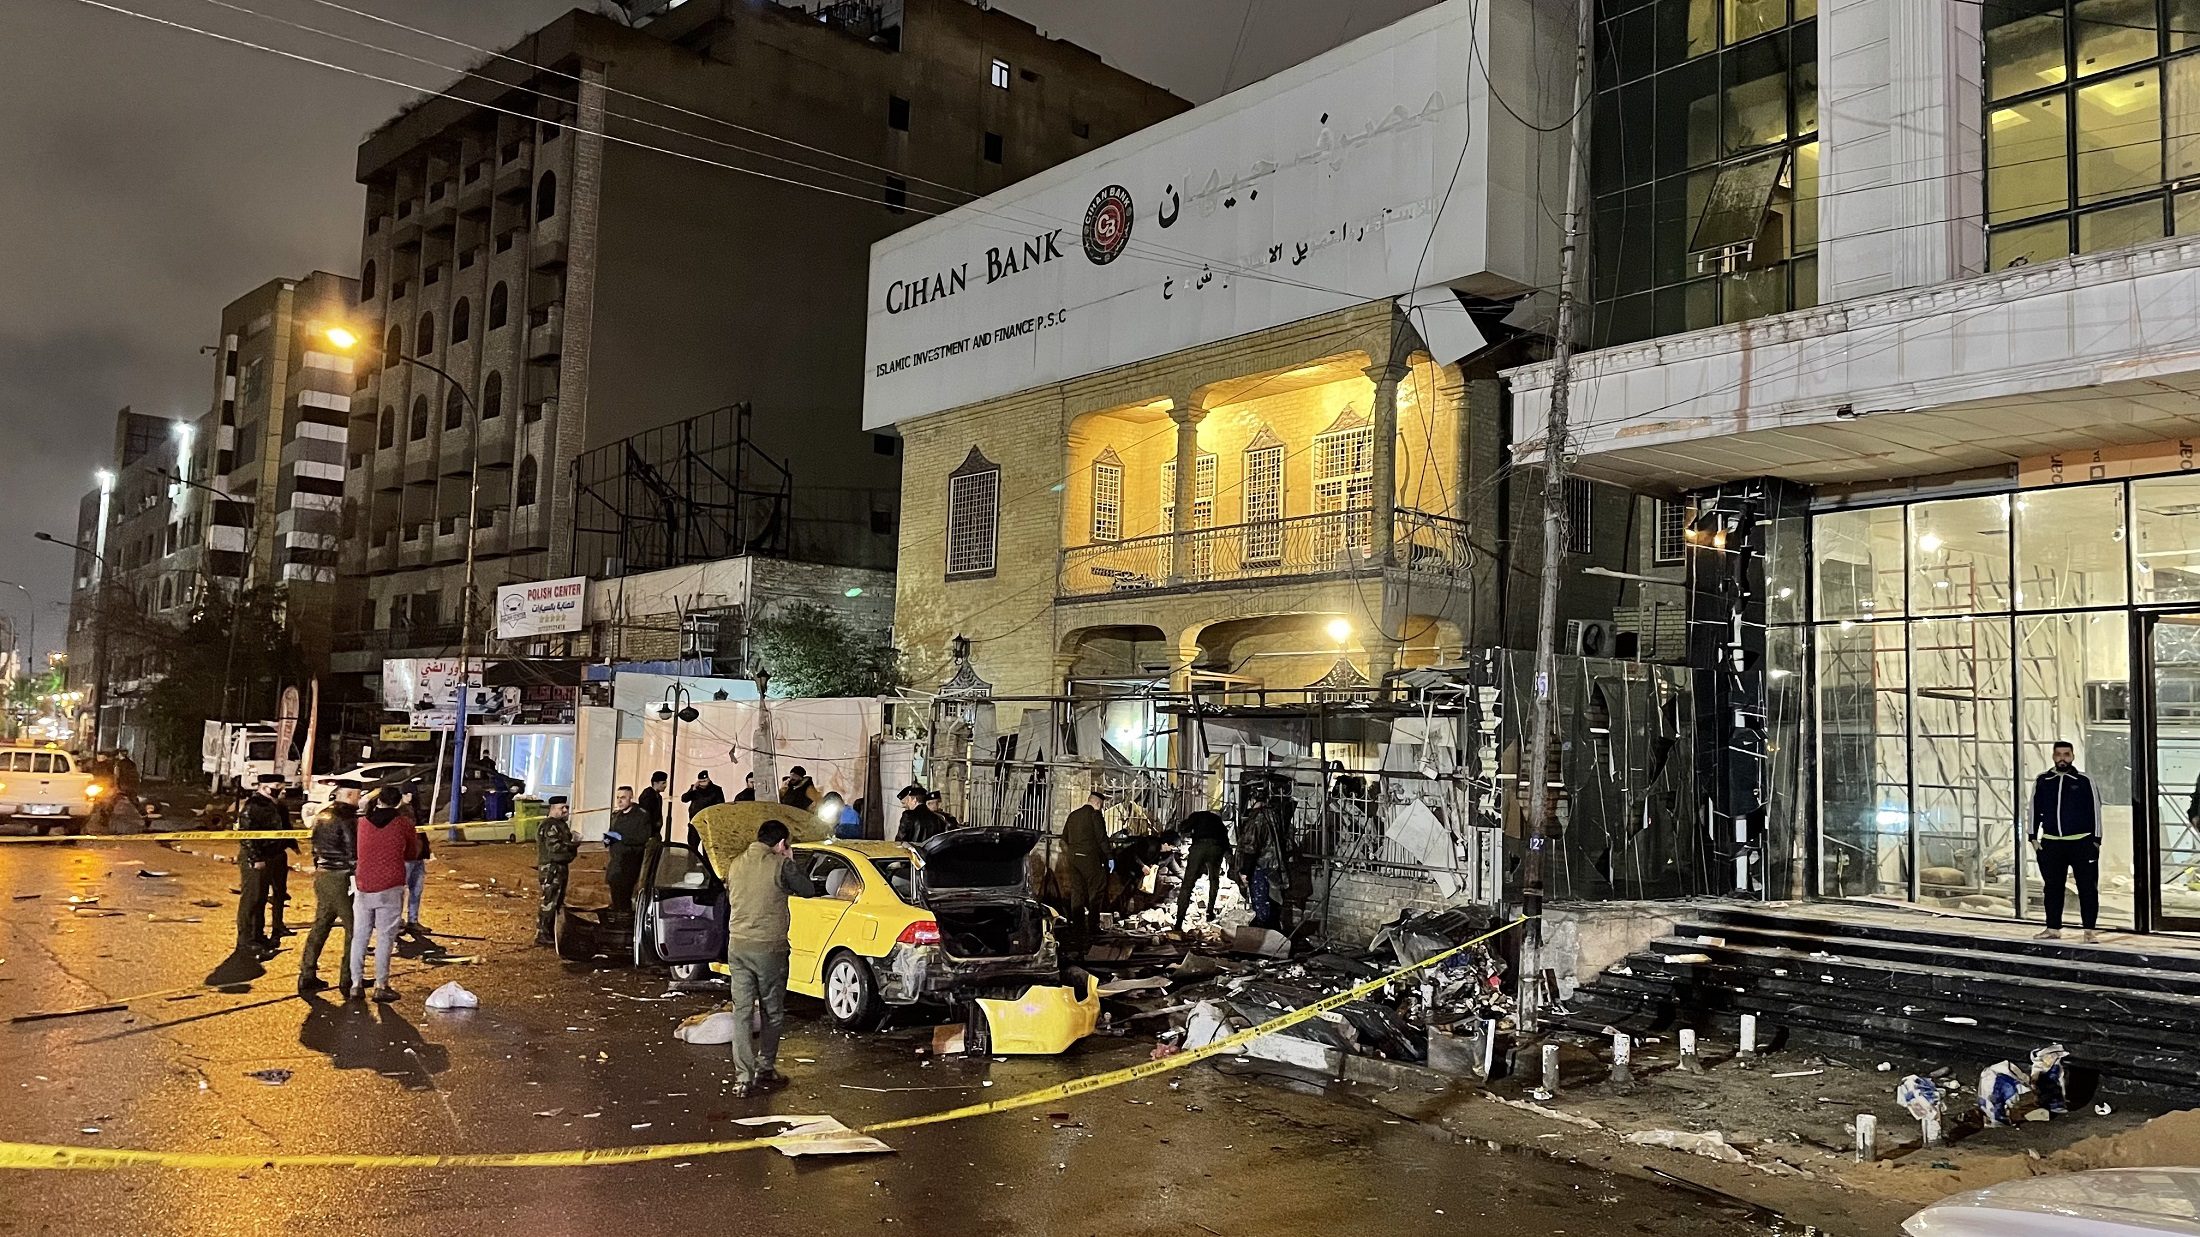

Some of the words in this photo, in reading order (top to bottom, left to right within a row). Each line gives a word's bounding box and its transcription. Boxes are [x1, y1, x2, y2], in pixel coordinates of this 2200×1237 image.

[1085, 189, 1107, 224] CIHAN
[1109, 187, 1131, 208] BANK
[886, 262, 968, 314] CIHAN
[985, 228, 1064, 284] BANK
[876, 355, 911, 377] ISLAMIC
[913, 338, 970, 367] INVESTMENT
[972, 332, 992, 350] AND
[994, 318, 1034, 343] FINANCE
[527, 586, 552, 600] POLISH
[554, 583, 581, 597] CENTER
